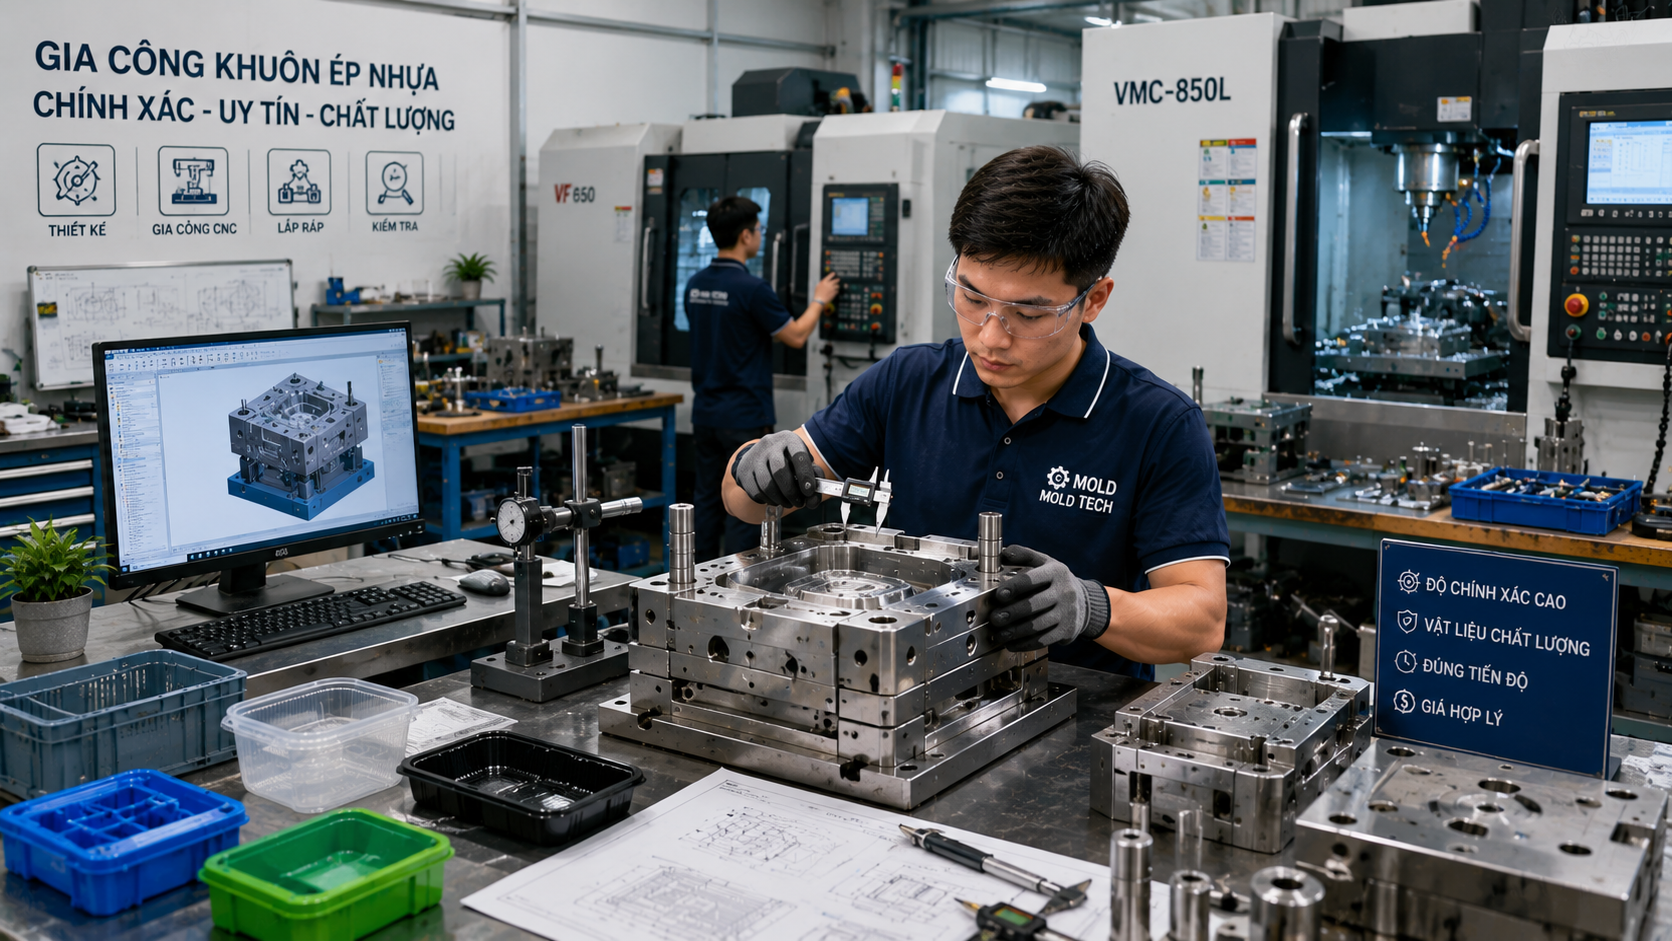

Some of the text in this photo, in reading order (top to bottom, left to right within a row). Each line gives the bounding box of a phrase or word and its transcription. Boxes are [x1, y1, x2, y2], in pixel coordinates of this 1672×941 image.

[35, 39, 440, 96] GIA CÔNG KHUÔN ÉP NHỰA
[1114, 76, 1231, 105] VMC-850L
[33, 86, 128, 120] CHÍNH
[137, 90, 195, 123] XÁC
[219, 99, 254, 125] UY
[260, 97, 300, 126] TÍN
[320, 98, 379, 128] CHẤT
[385, 105, 455, 135] LƯỢNG
[554, 183, 596, 204] VF 650
[152, 223, 173, 235] GIA
[213, 223, 237, 234] CNC
[302, 219, 324, 233] RÁP
[399, 221, 419, 231] TRA
[1072, 474, 1117, 495] MOLD
[1039, 489, 1114, 514] MOLD TECH
[1426, 576, 1566, 610] ĐỘ CHÍNH XÁC CAO
[1424, 616, 1590, 657] VẬT LIỆU CHẤT LƯỢNG
[1422, 657, 1529, 693] ĐÚNG TIẾN ĐỘ
[1421, 698, 1503, 727] GIÁ HỢP LÝ
